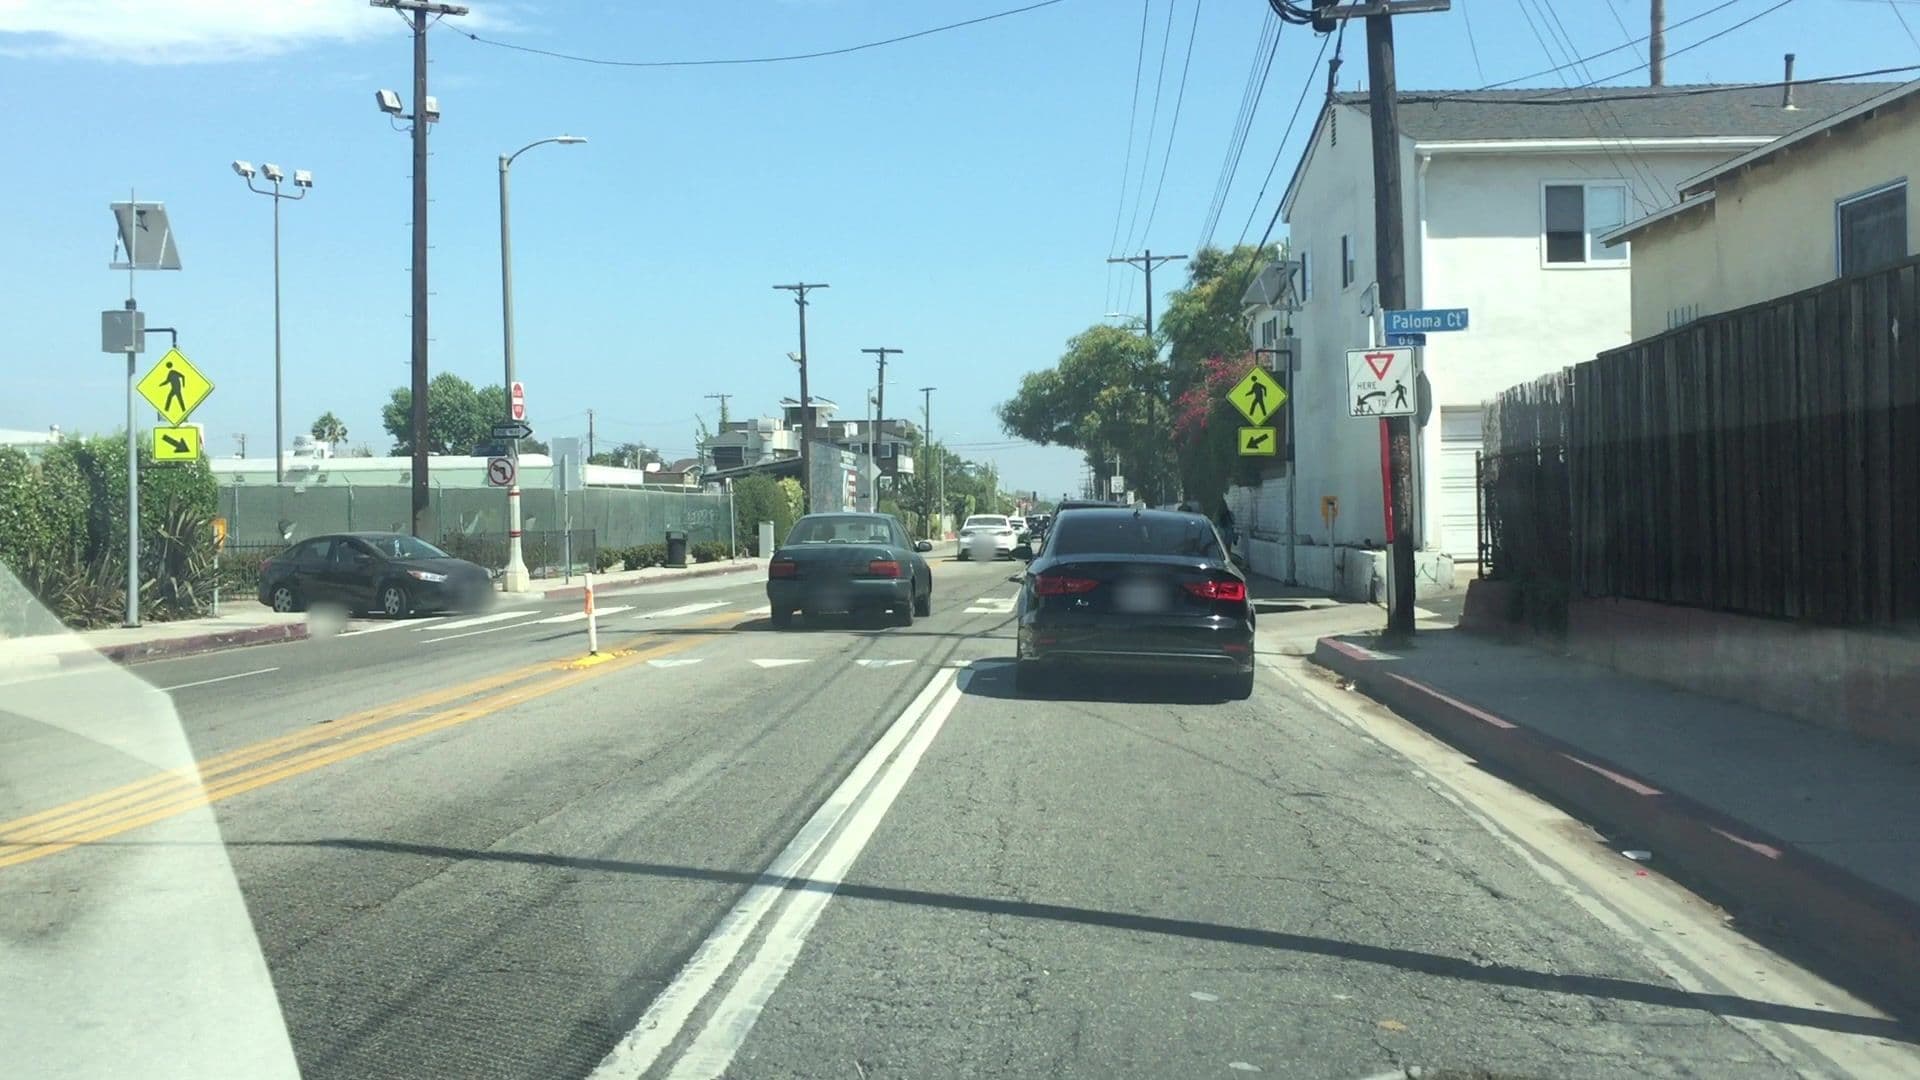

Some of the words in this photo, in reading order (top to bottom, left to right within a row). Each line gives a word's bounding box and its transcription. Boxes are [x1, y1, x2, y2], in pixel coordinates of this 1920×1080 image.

[1391, 314, 1441, 329] Paloma
[1446, 312, 1462, 327] Ct
[1357, 381, 1376, 390] HERE
[1378, 399, 1387, 407] TO
